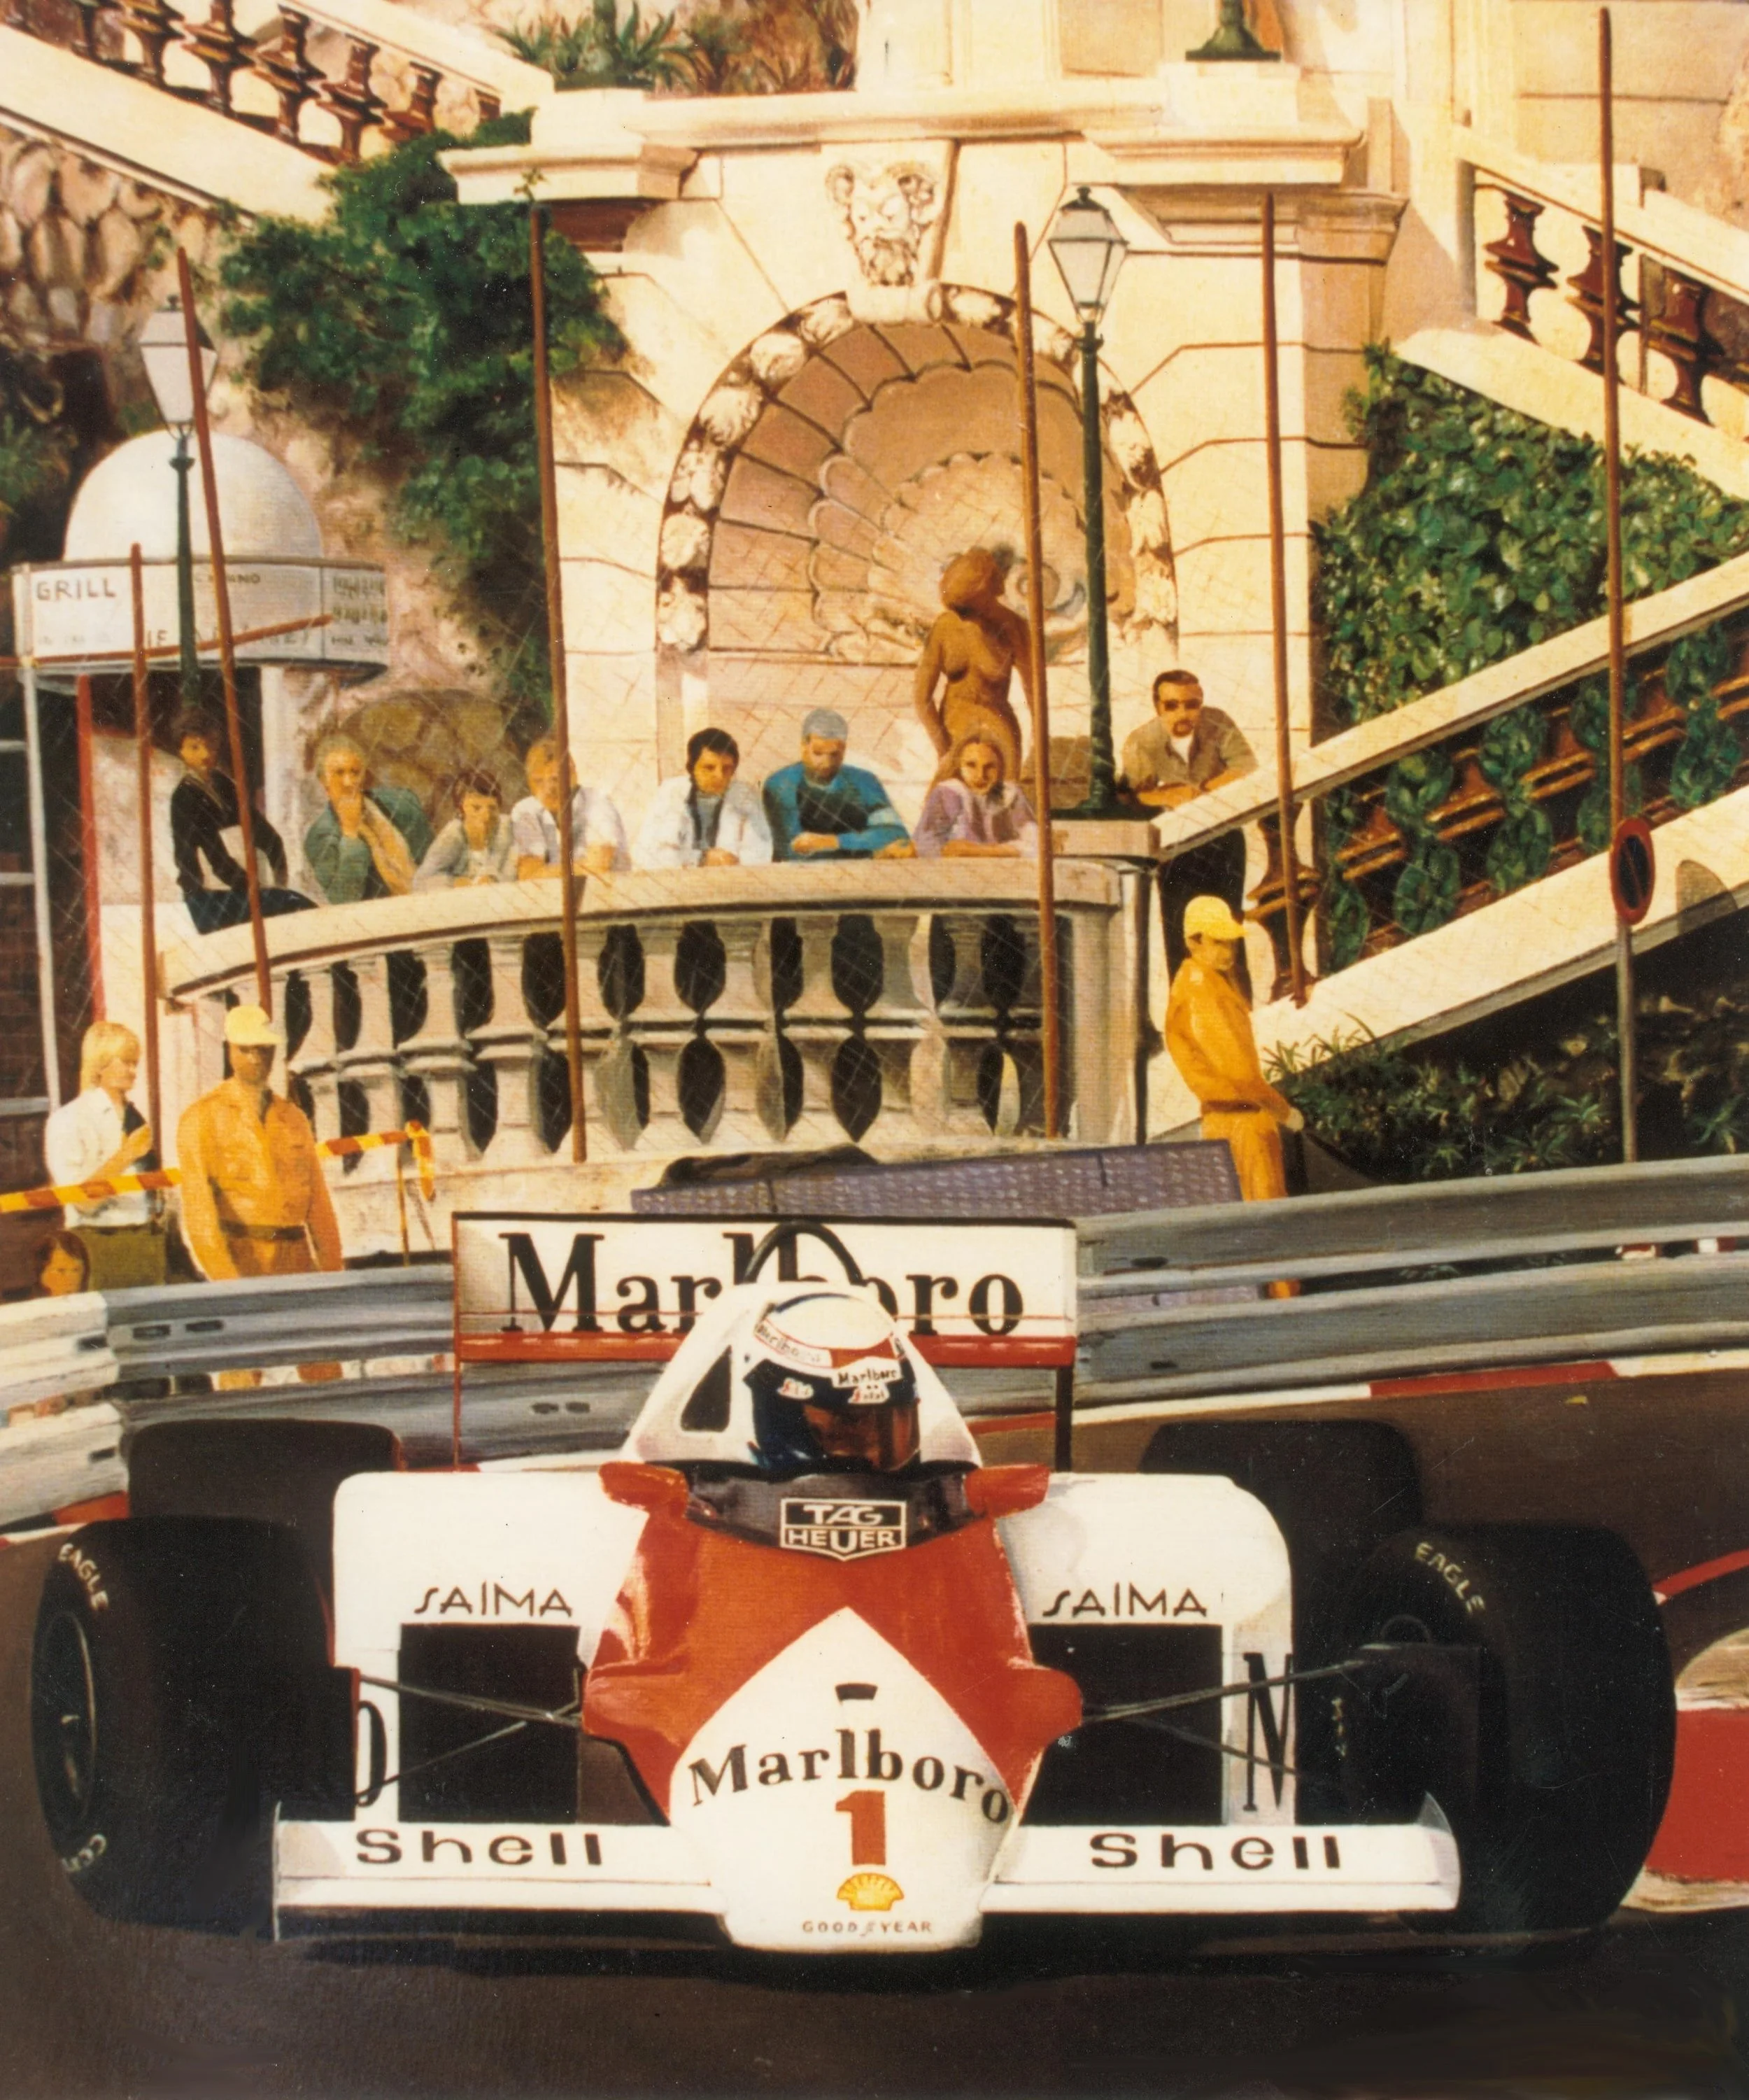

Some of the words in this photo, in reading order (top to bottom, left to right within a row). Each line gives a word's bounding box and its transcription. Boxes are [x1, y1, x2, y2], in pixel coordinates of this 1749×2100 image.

[36, 577, 116, 600] GRILL
[499, 1232, 1024, 1336] Marro
[788, 1528, 897, 1554] HEUER
[802, 1504, 884, 1526] TAG
[58, 1542, 109, 1610] EAGLE
[1415, 1541, 1486, 1614] EAGLE
[686, 1728, 1010, 1824] Marlboro
[356, 1828, 603, 1867] Shell
[835, 1790, 886, 1866] 1
[1089, 1833, 1341, 1871] Shell
